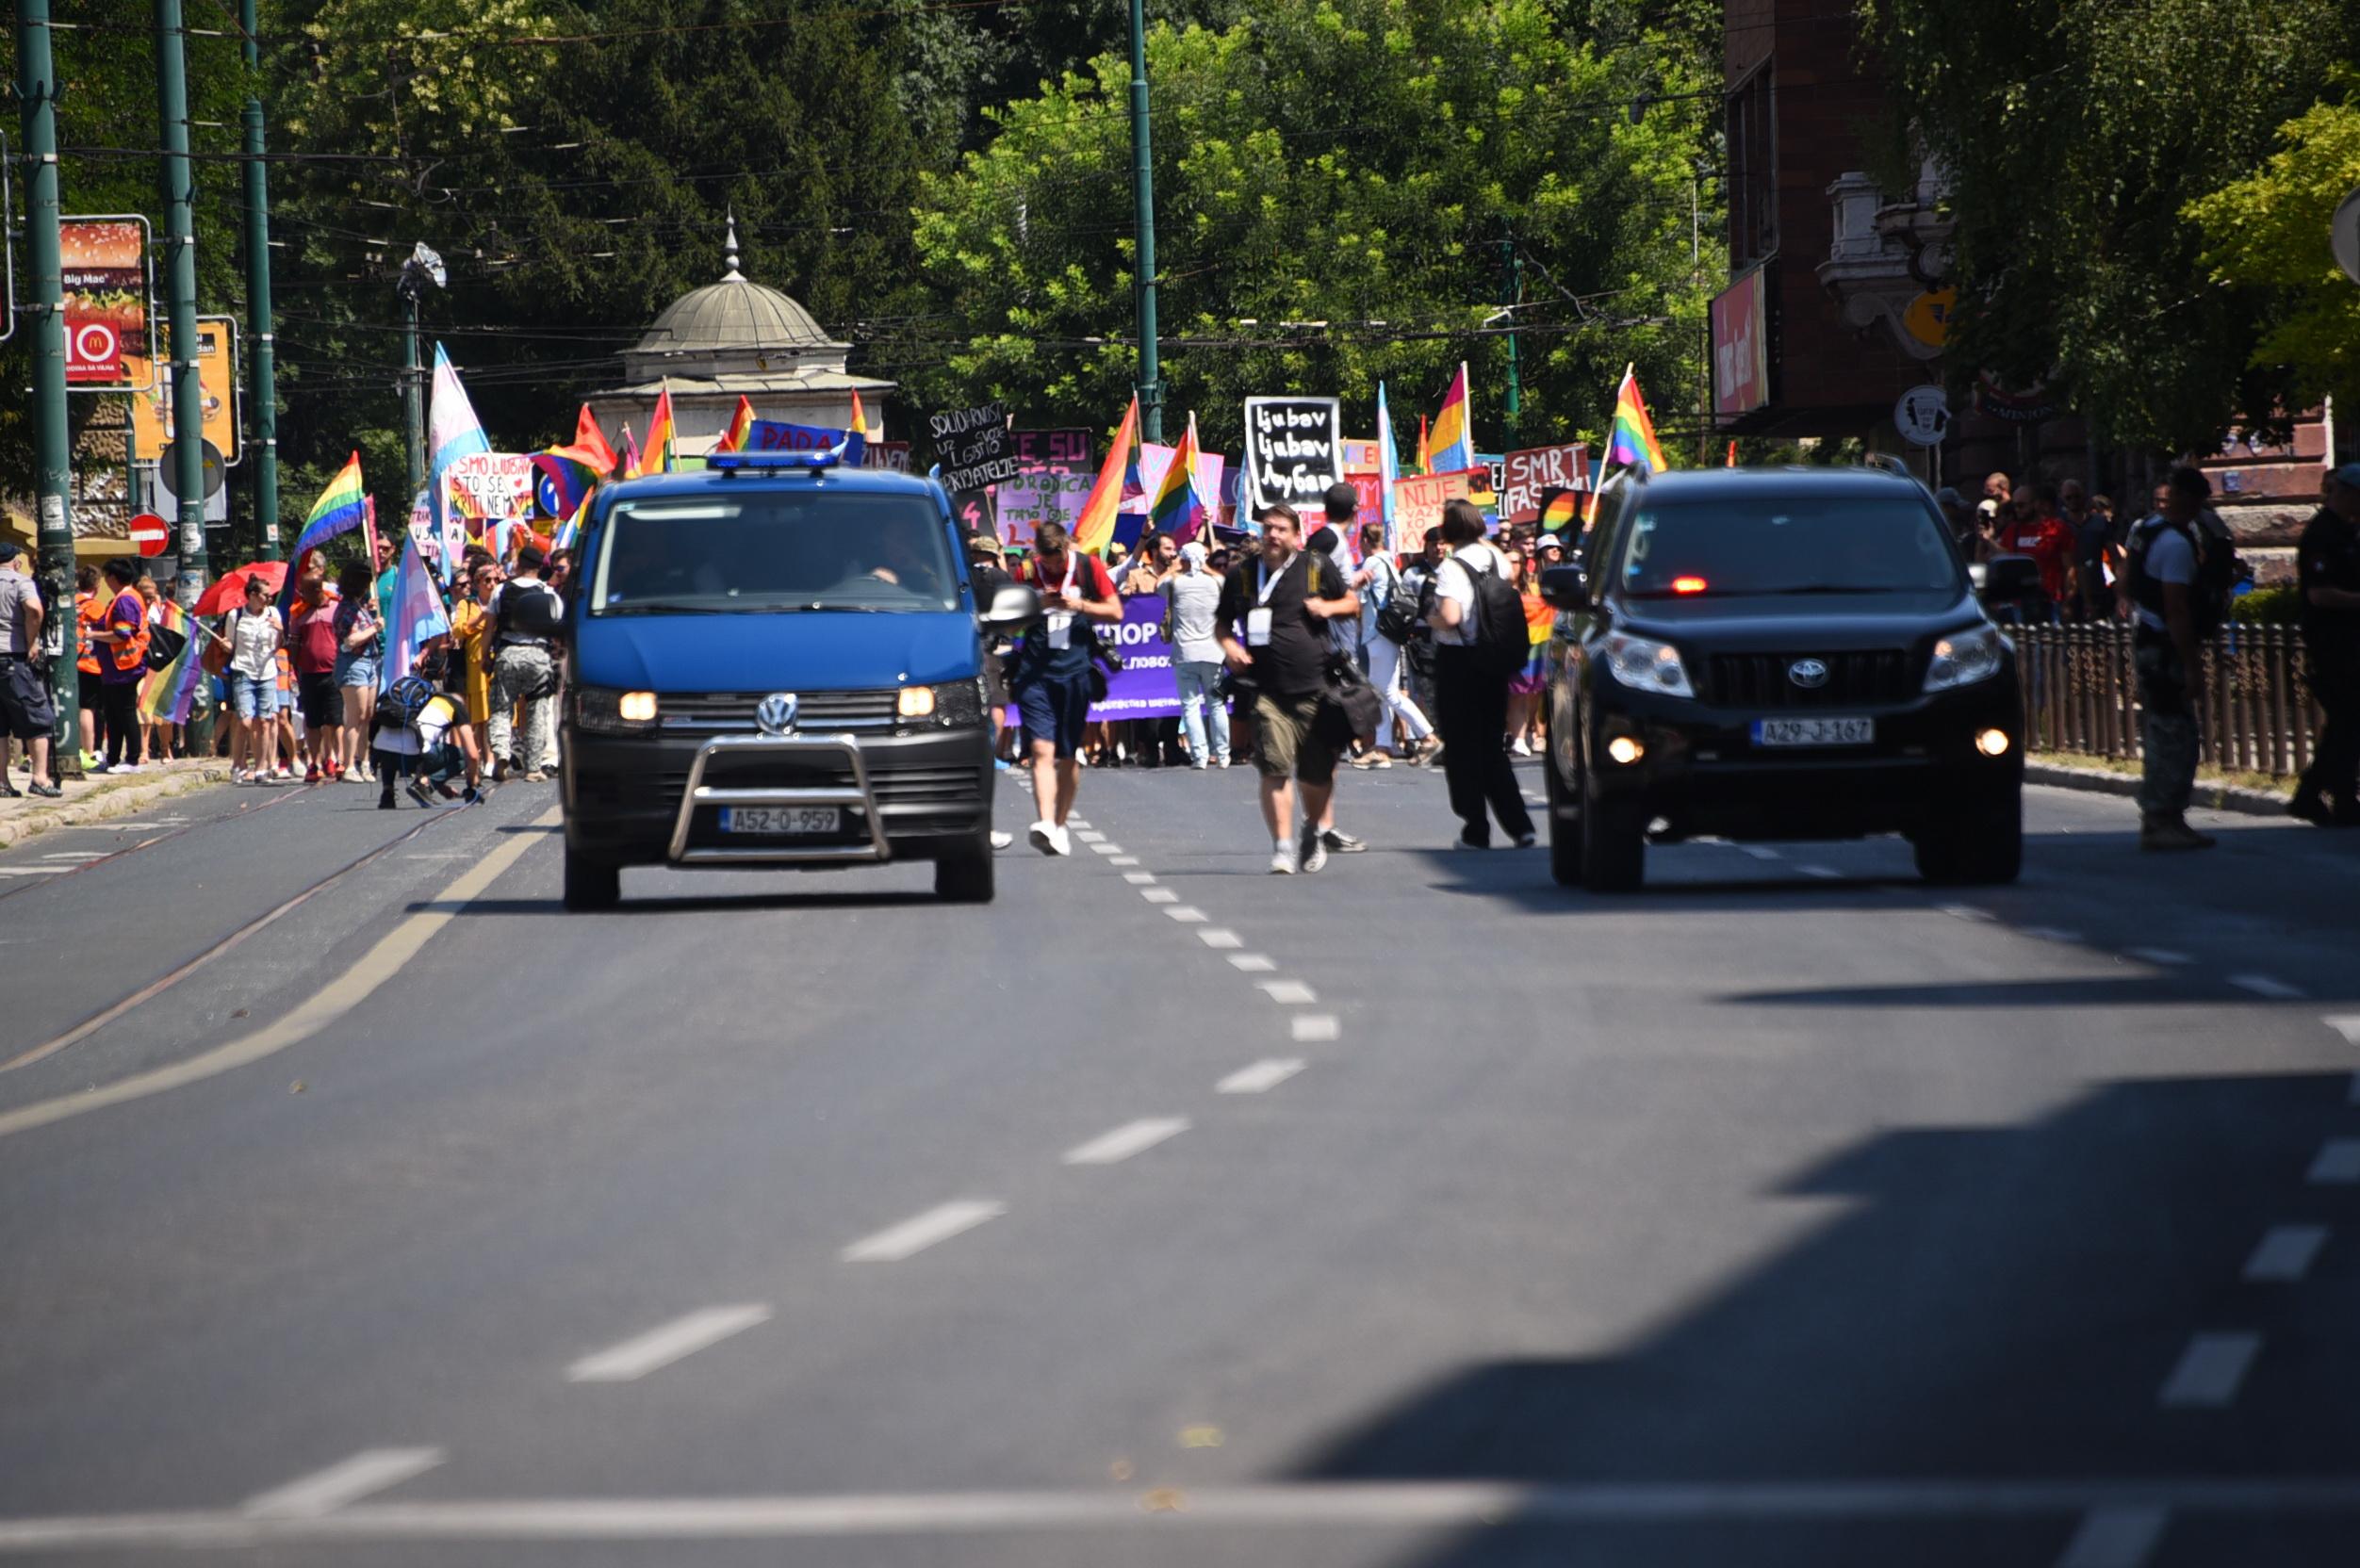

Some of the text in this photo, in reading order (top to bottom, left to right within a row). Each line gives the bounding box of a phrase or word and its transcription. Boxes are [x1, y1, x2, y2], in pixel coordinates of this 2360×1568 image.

[64, 274, 81, 286] Big
[929, 403, 1001, 438] SOLIDARNOST
[1256, 405, 1325, 433] ljubav
[936, 439, 956, 455] UZ
[1258, 432, 1330, 462] ljubav
[459, 456, 488, 475] SMO
[1511, 446, 1584, 482] SMRT
[487, 476, 504, 493] SE
[1403, 480, 1456, 508] NIJE
[487, 496, 500, 515] NE
[1032, 494, 1053, 510] JE
[1764, 720, 1869, 743] A29-J-167
